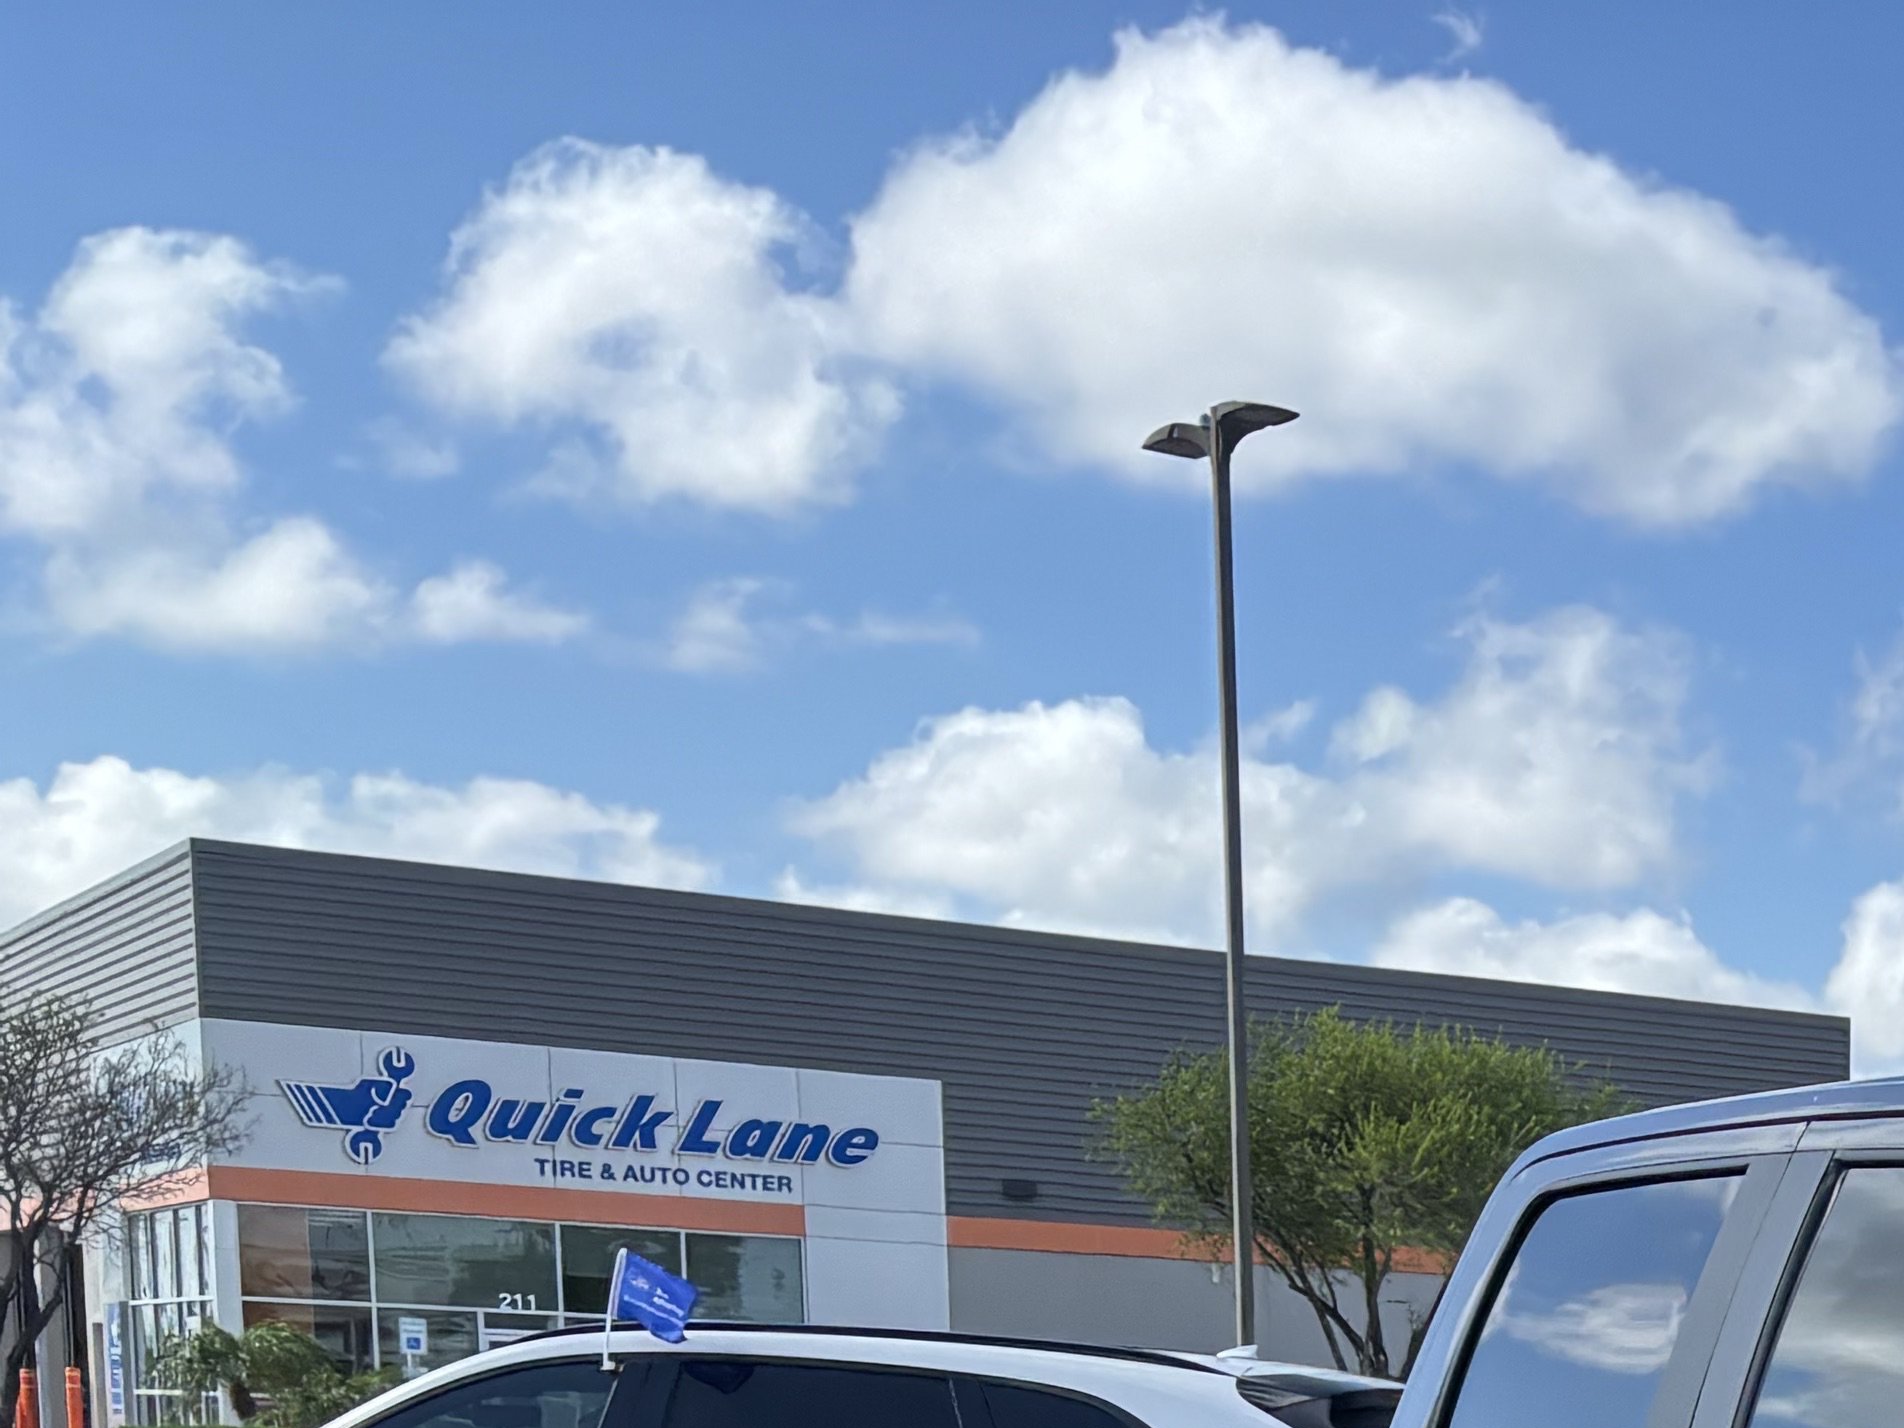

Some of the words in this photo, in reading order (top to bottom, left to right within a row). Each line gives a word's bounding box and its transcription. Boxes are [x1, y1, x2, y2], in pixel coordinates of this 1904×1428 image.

[426, 1079, 674, 1151] Quick
[675, 1099, 880, 1167] Lane
[534, 1158, 593, 1180] TIRE
[600, 1162, 616, 1182] &
[622, 1164, 690, 1187] AUTO
[699, 1169, 793, 1194] CENTER
[498, 1292, 536, 1313] 211
